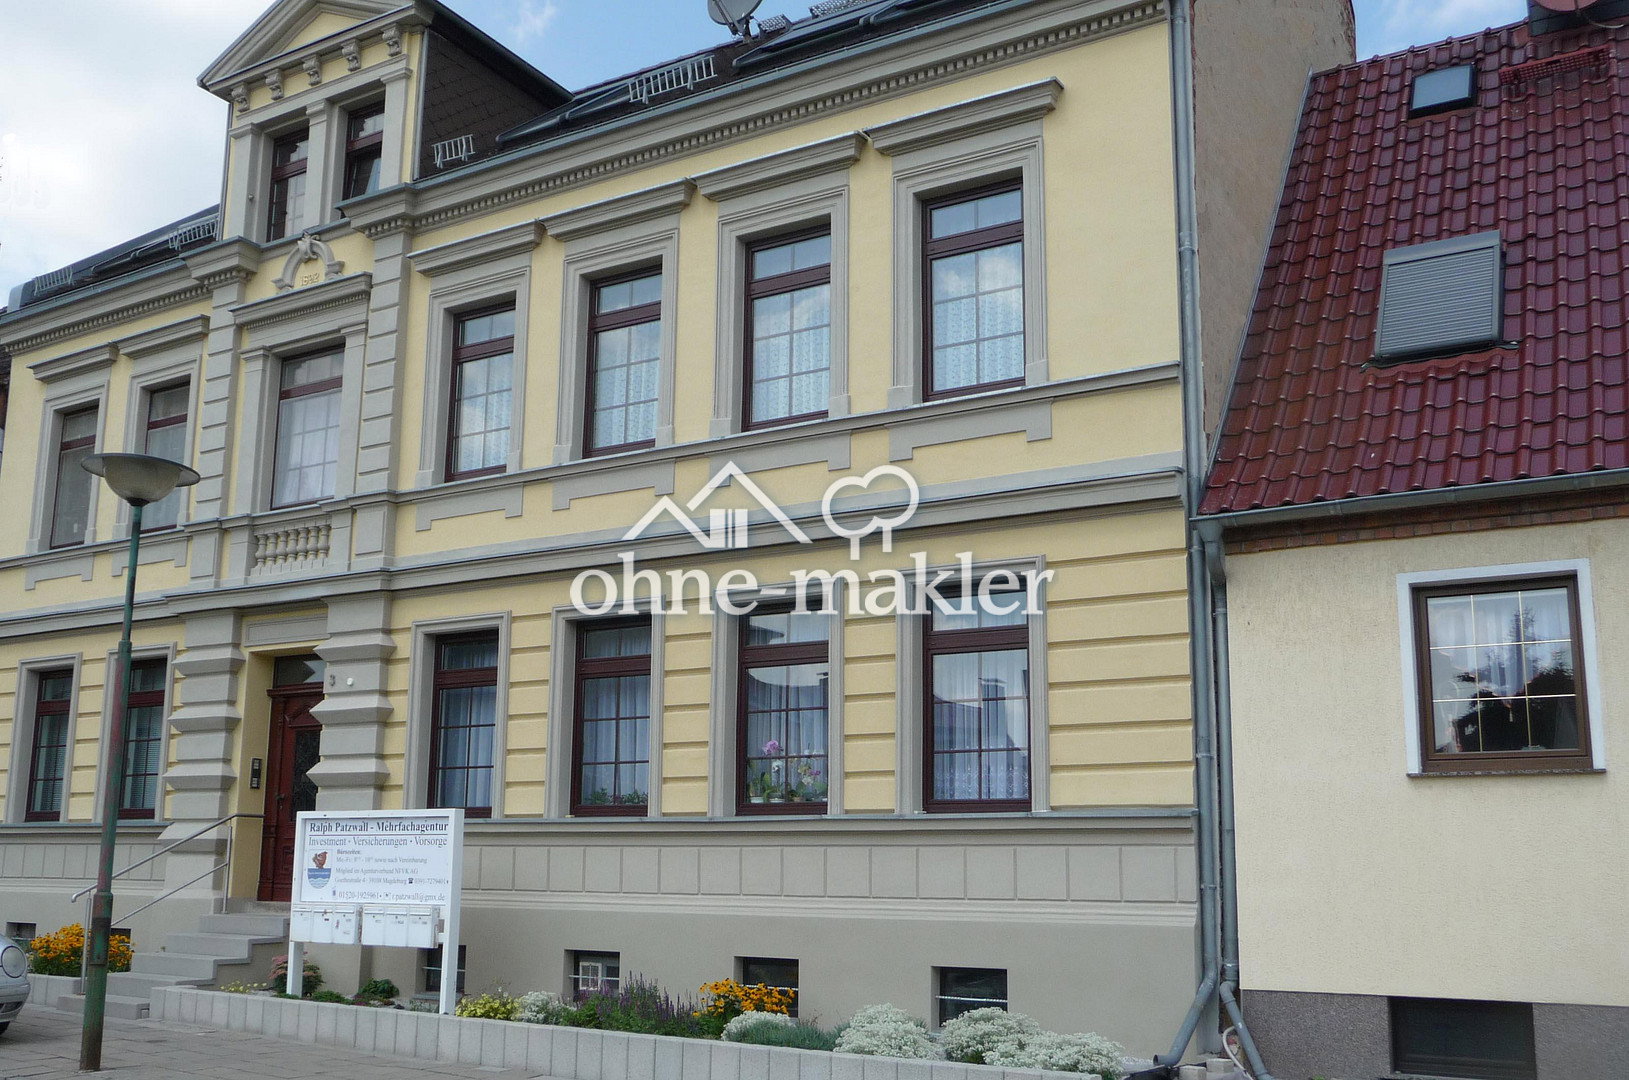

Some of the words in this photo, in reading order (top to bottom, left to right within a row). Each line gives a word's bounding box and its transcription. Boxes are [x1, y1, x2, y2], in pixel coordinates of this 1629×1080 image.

[310, 822, 333, 834] Ralph
[335, 821, 369, 832] Patzwall
[376, 821, 448, 833] Mehrfachagentur
[309, 837, 346, 846] Investment
[353, 836, 407, 848] Versicherungen
[415, 836, 447, 847] Vorsorge
